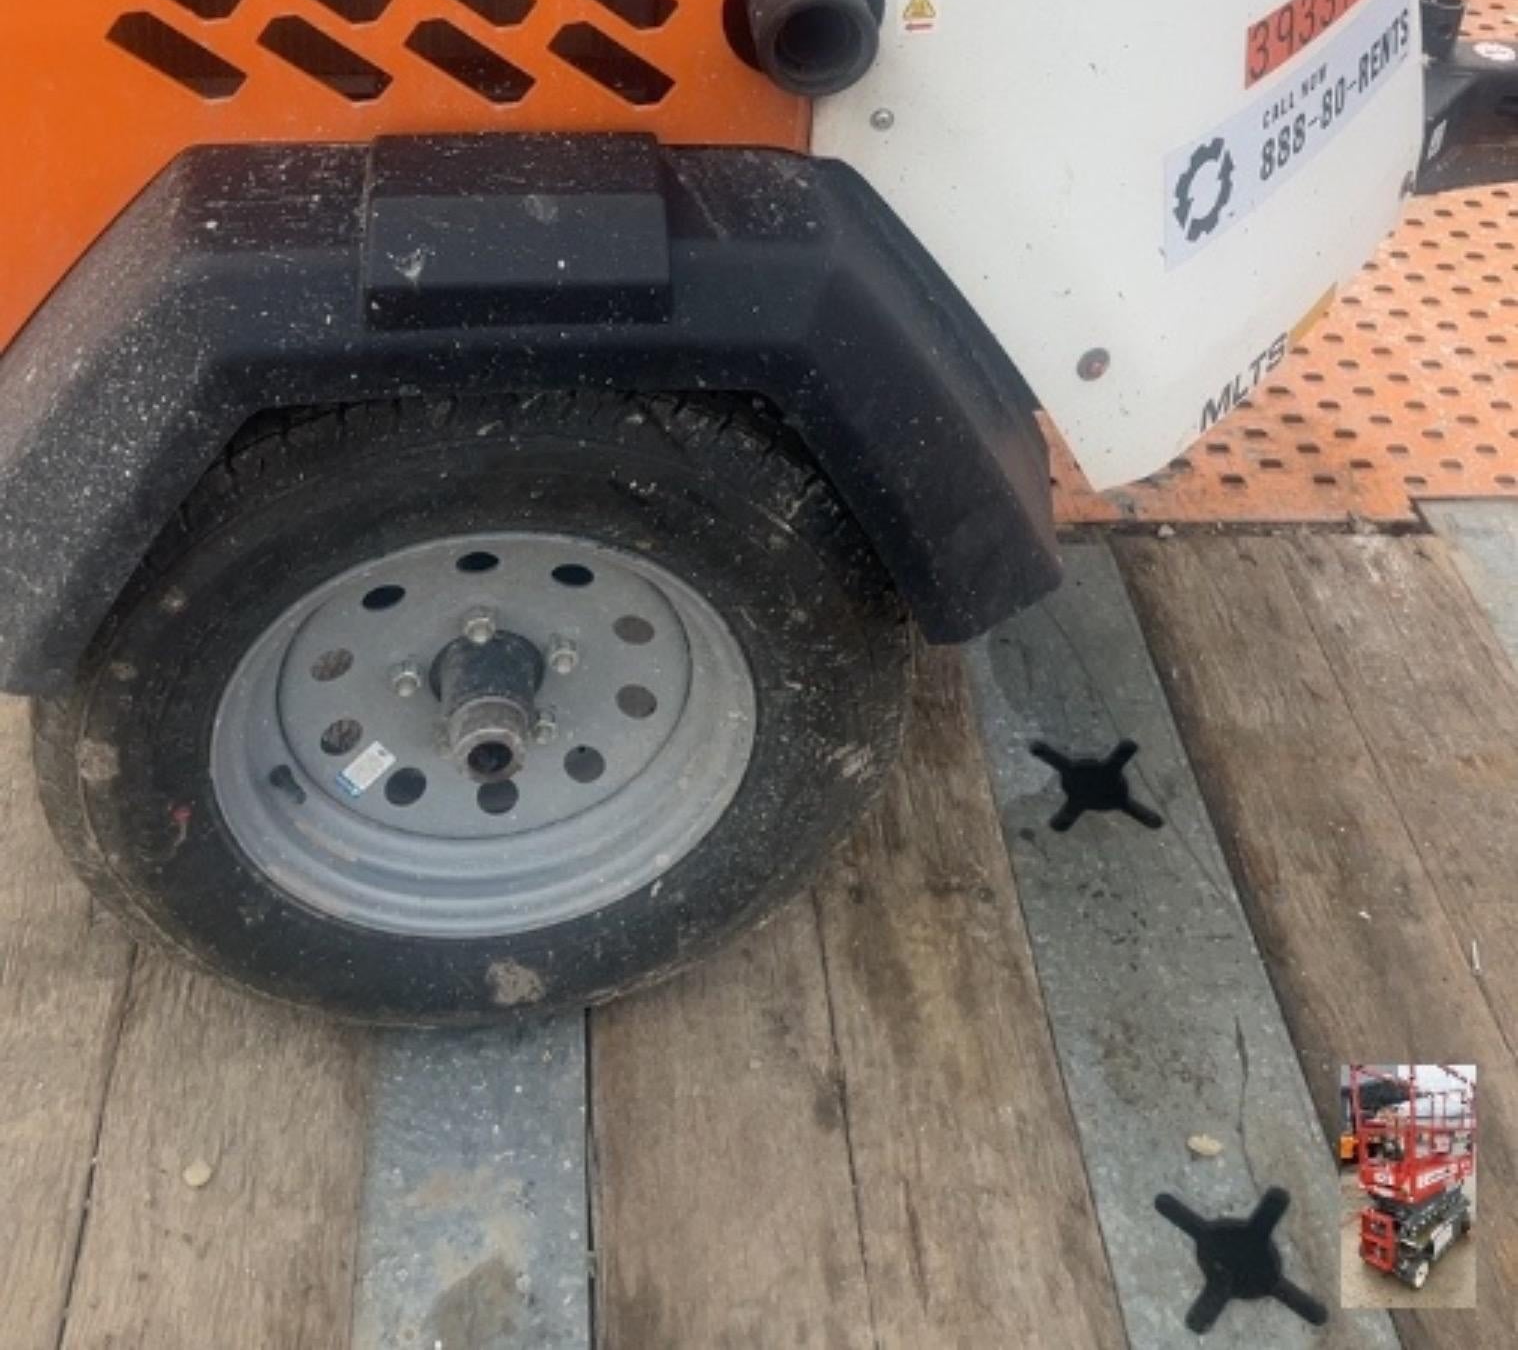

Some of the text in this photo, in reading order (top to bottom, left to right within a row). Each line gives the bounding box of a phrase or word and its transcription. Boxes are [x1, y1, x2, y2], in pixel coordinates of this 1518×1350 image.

[1259, 7, 1409, 181] 888-80-RENTS
[1262, 62, 1328, 130] CALL NOW
